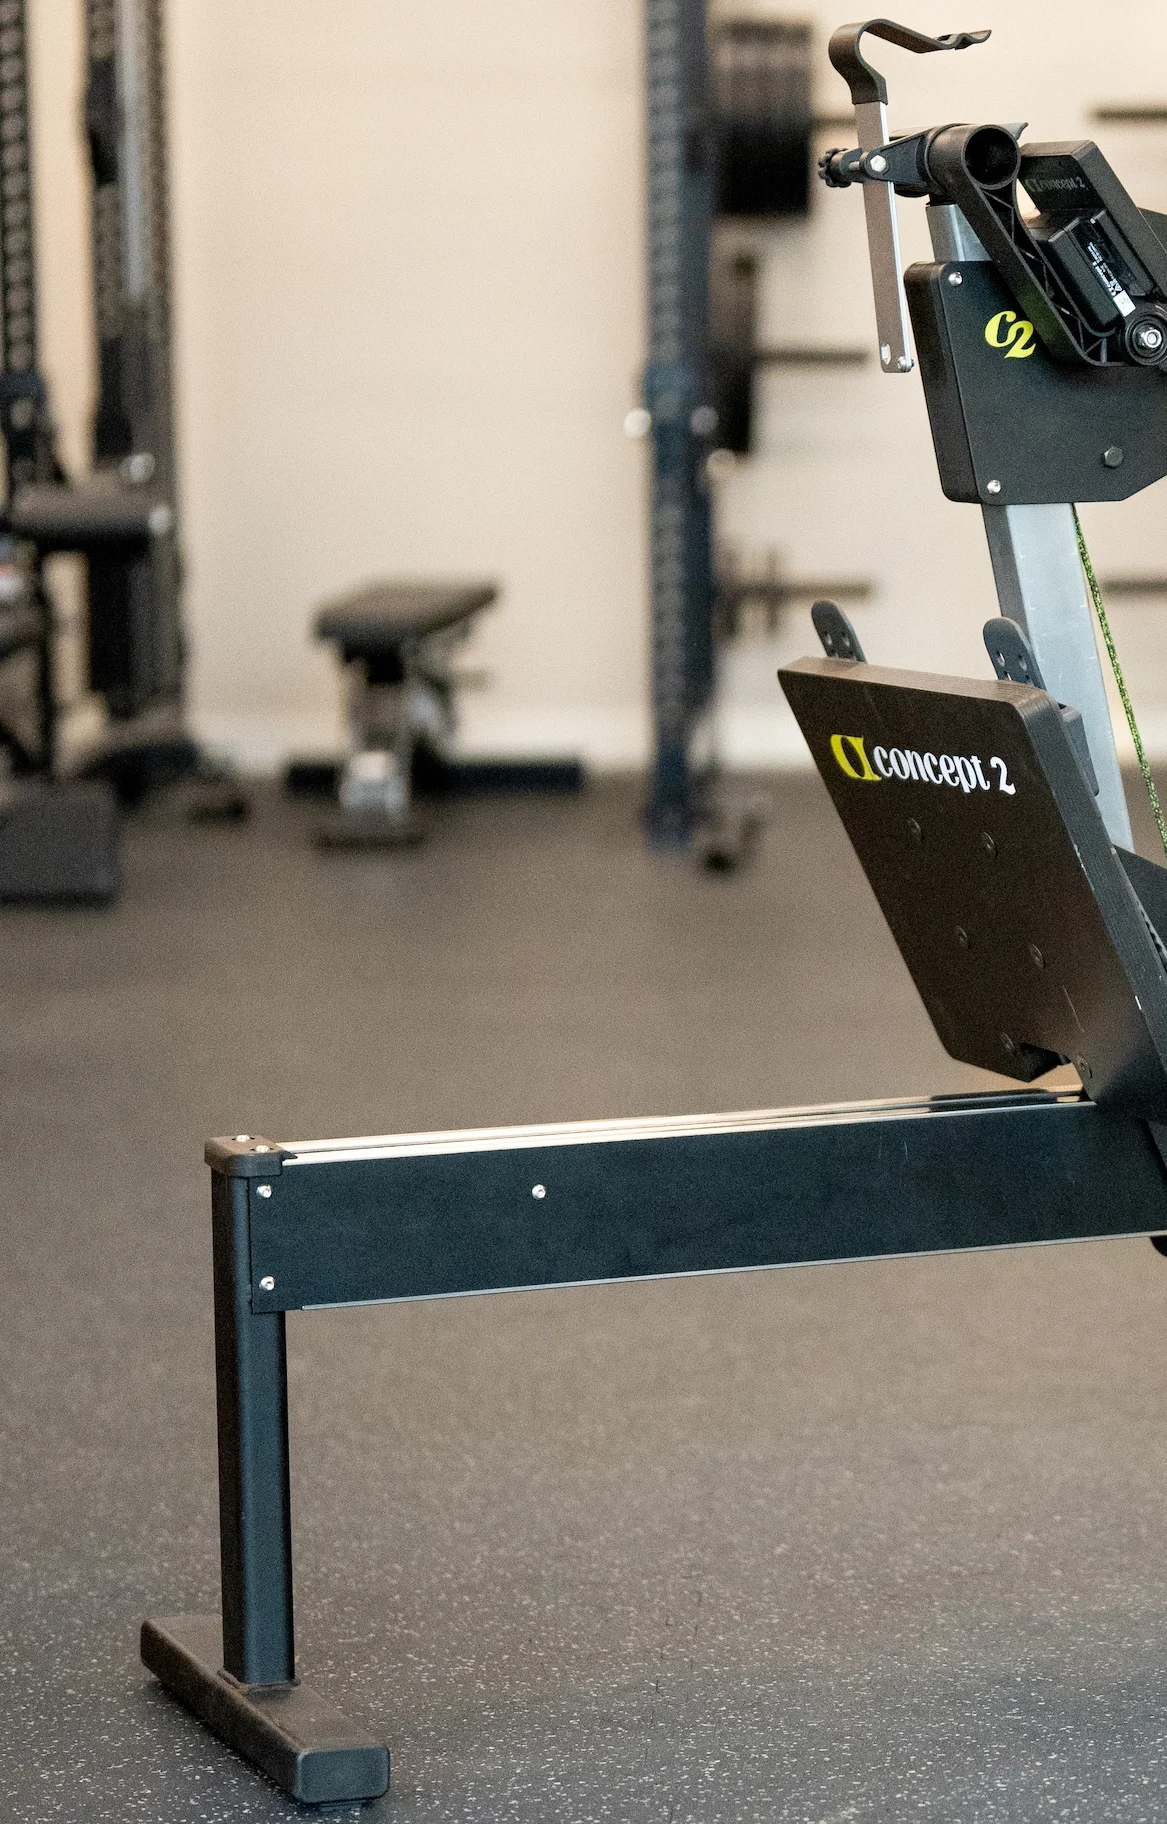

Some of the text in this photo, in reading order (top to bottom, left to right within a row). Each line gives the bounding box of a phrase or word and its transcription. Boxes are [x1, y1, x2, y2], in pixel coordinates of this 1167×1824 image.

[1076, 176, 1086, 188] 2
[984, 310, 1035, 359] C2
[873, 745, 1017, 795] concept 2
